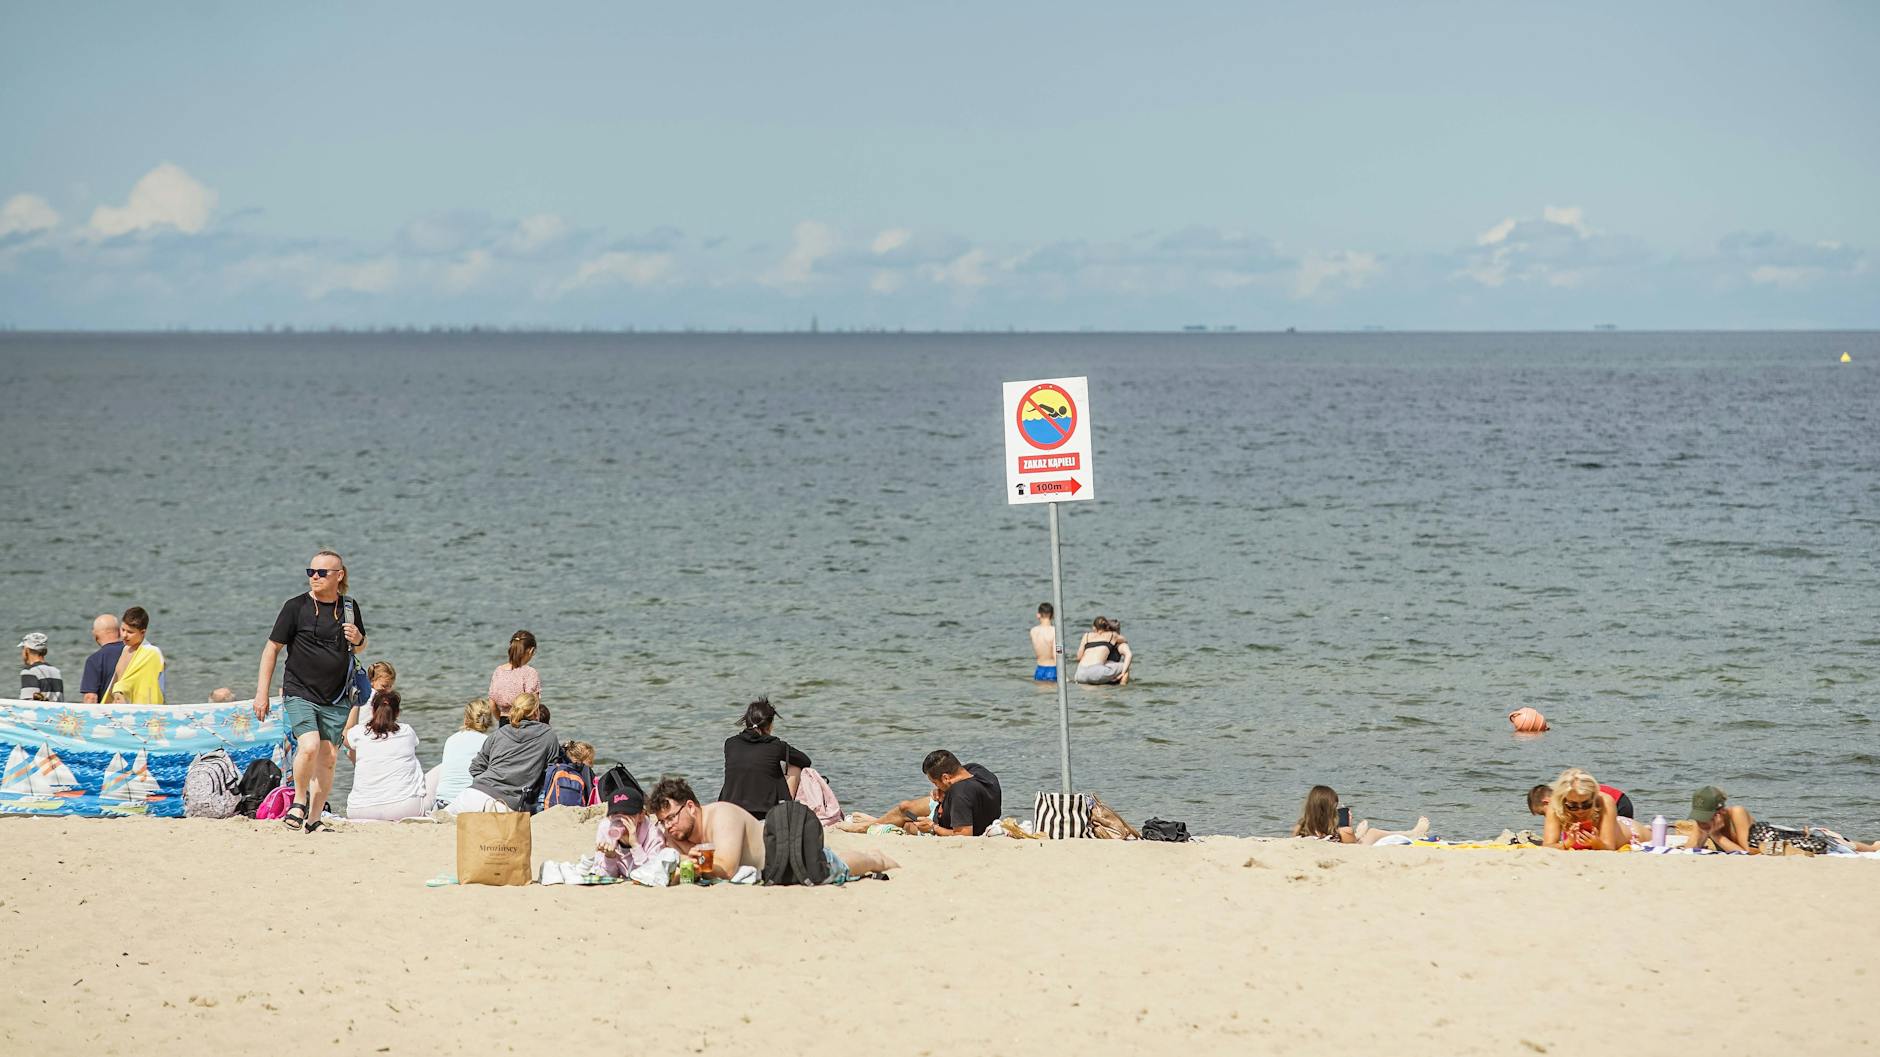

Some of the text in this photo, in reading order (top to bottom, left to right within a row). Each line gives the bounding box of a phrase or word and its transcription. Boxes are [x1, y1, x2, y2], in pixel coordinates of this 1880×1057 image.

[1024, 457, 1075, 469] ZAKAZ KĄPIELI
[1036, 483, 1062, 491] 100m
